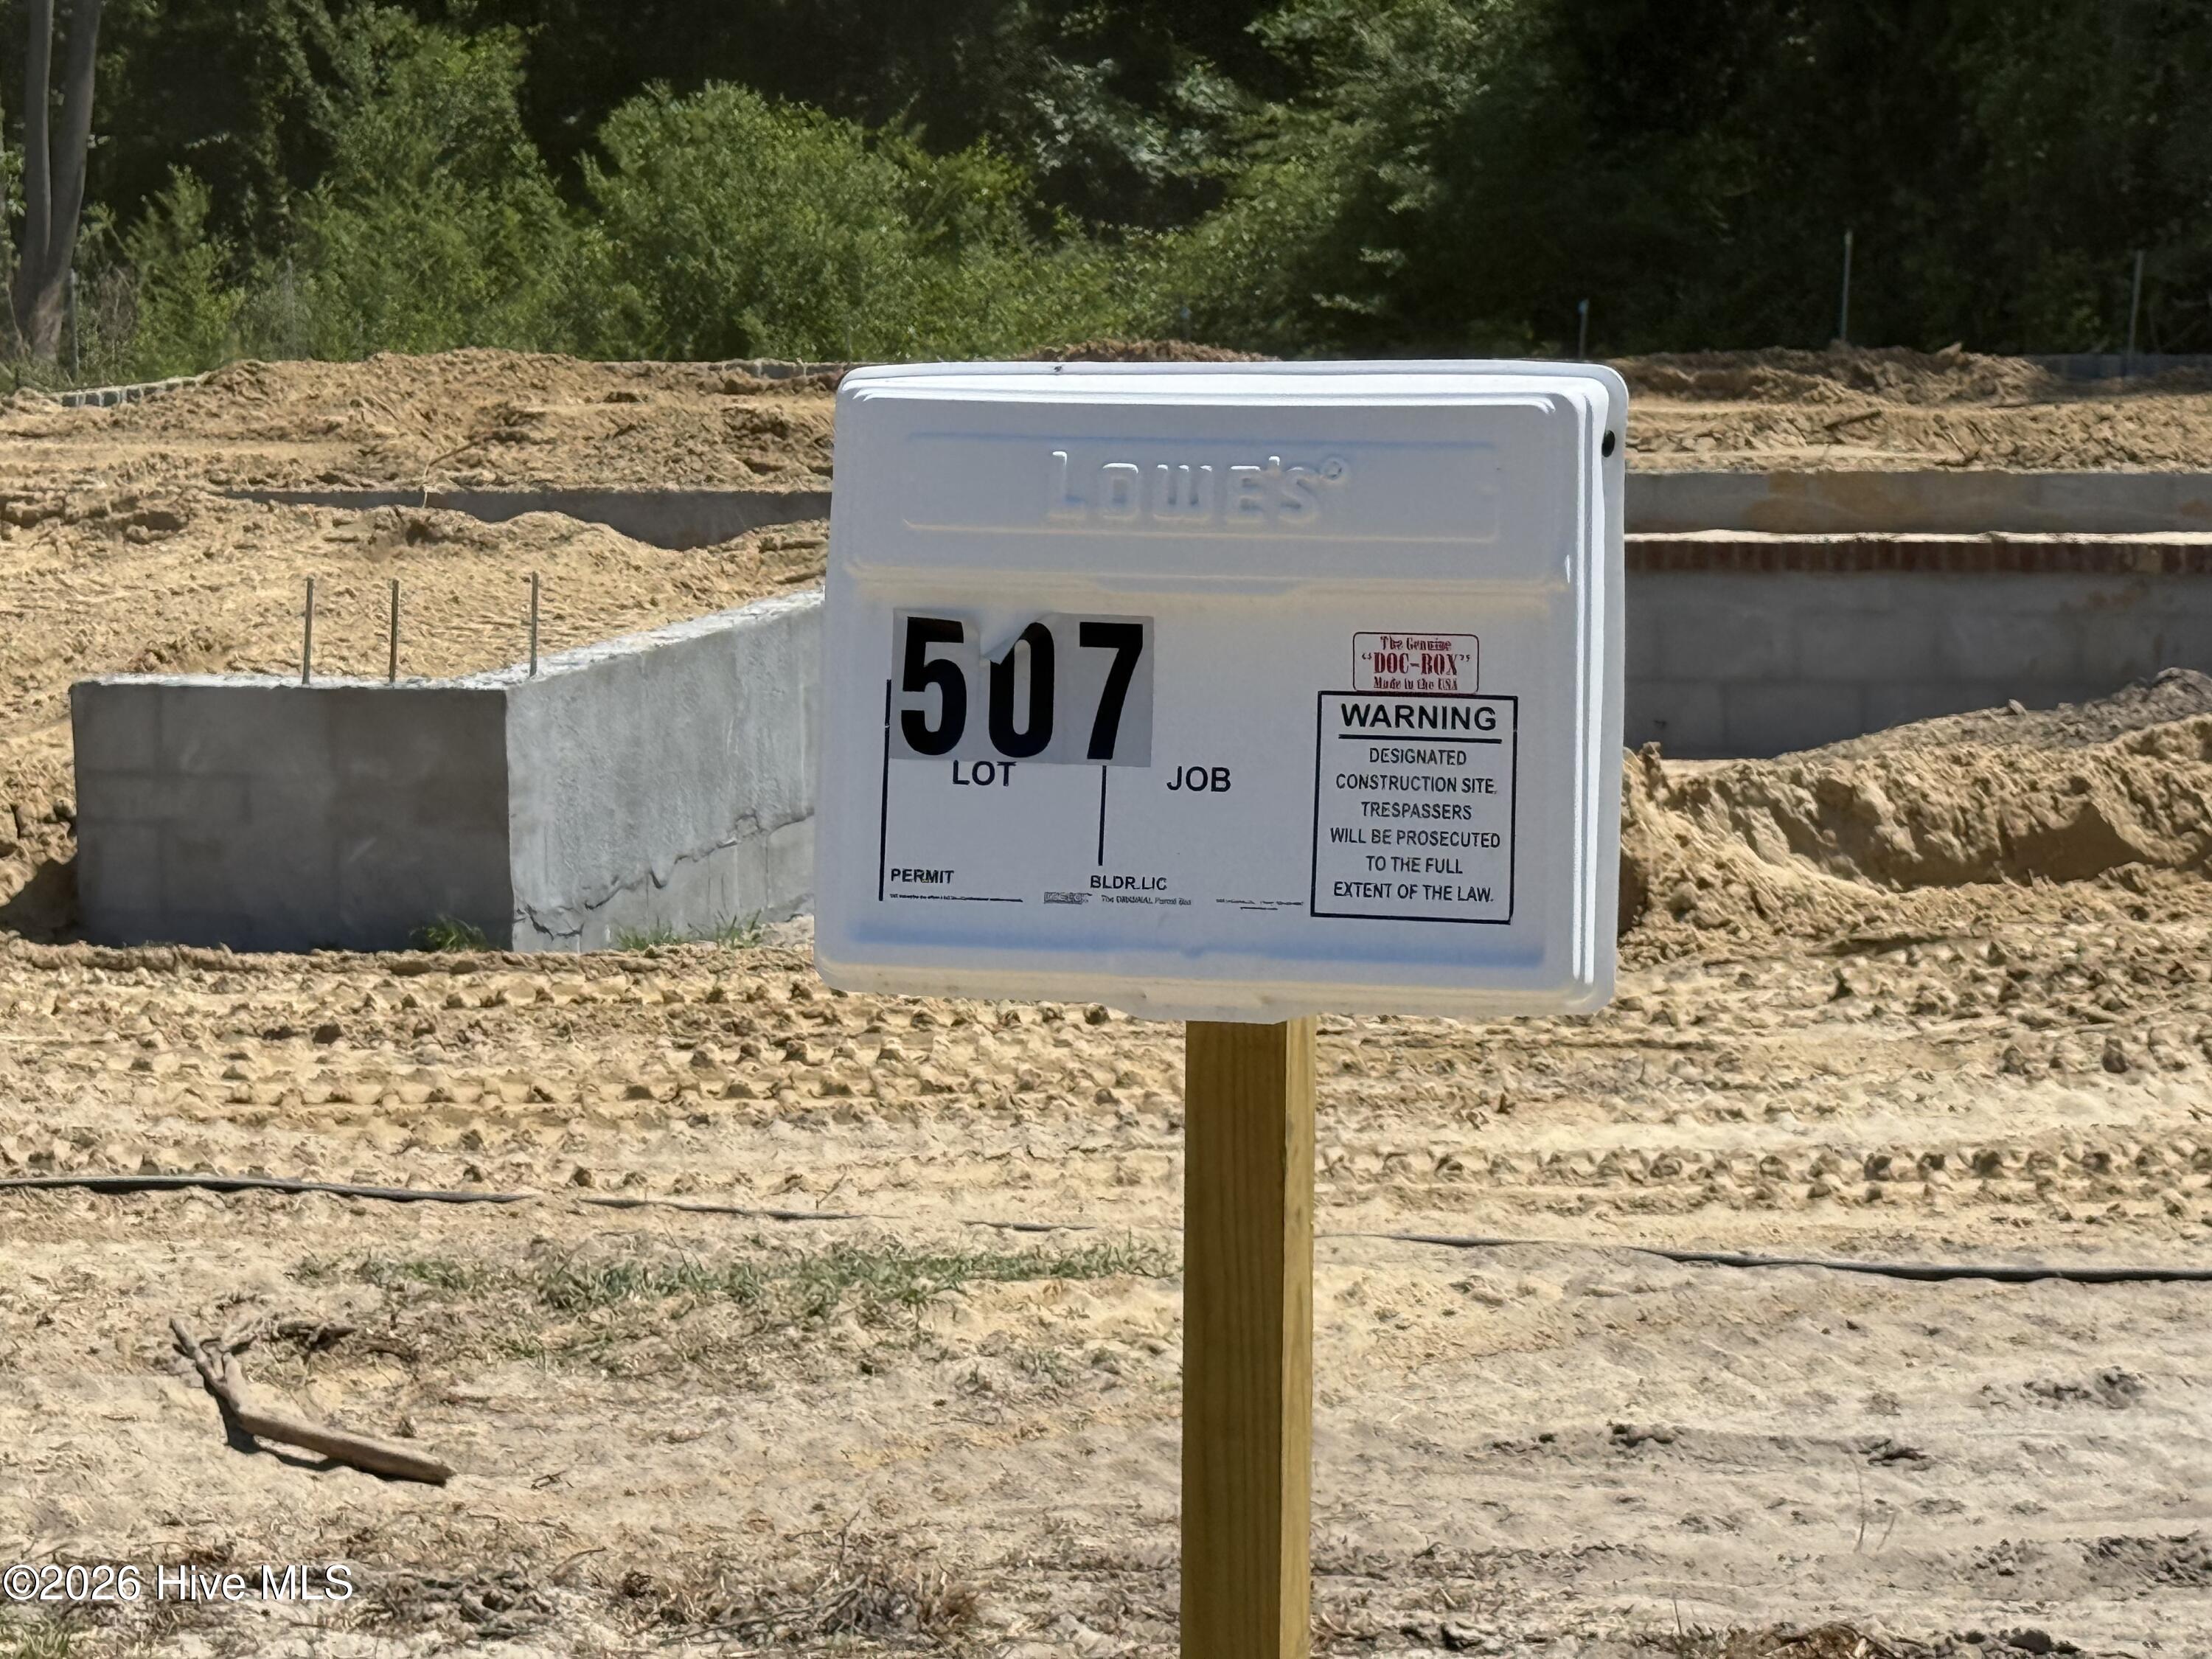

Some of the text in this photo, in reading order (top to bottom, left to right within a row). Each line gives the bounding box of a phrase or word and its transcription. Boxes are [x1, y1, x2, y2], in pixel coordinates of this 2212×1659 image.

[1380, 636, 1452, 652] The Genuine
[900, 616, 1144, 760] 507
[1374, 675, 1401, 690] Made
[1340, 702, 1497, 731] WARNING
[1368, 747, 1467, 766] DESIGNATED
[952, 759, 1017, 787] LOT
[1166, 765, 1231, 793] JOB
[1335, 773, 1458, 793] CONSTRUCTION
[1360, 801, 1473, 821] TRESPASSERS
[1329, 827, 1501, 849] WILL BE PROSECUTED
[1365, 855, 1464, 875] TO THE FULL
[890, 868, 955, 884] PERMIT
[1333, 881, 1495, 903] EXTENT OF THE LAW.
